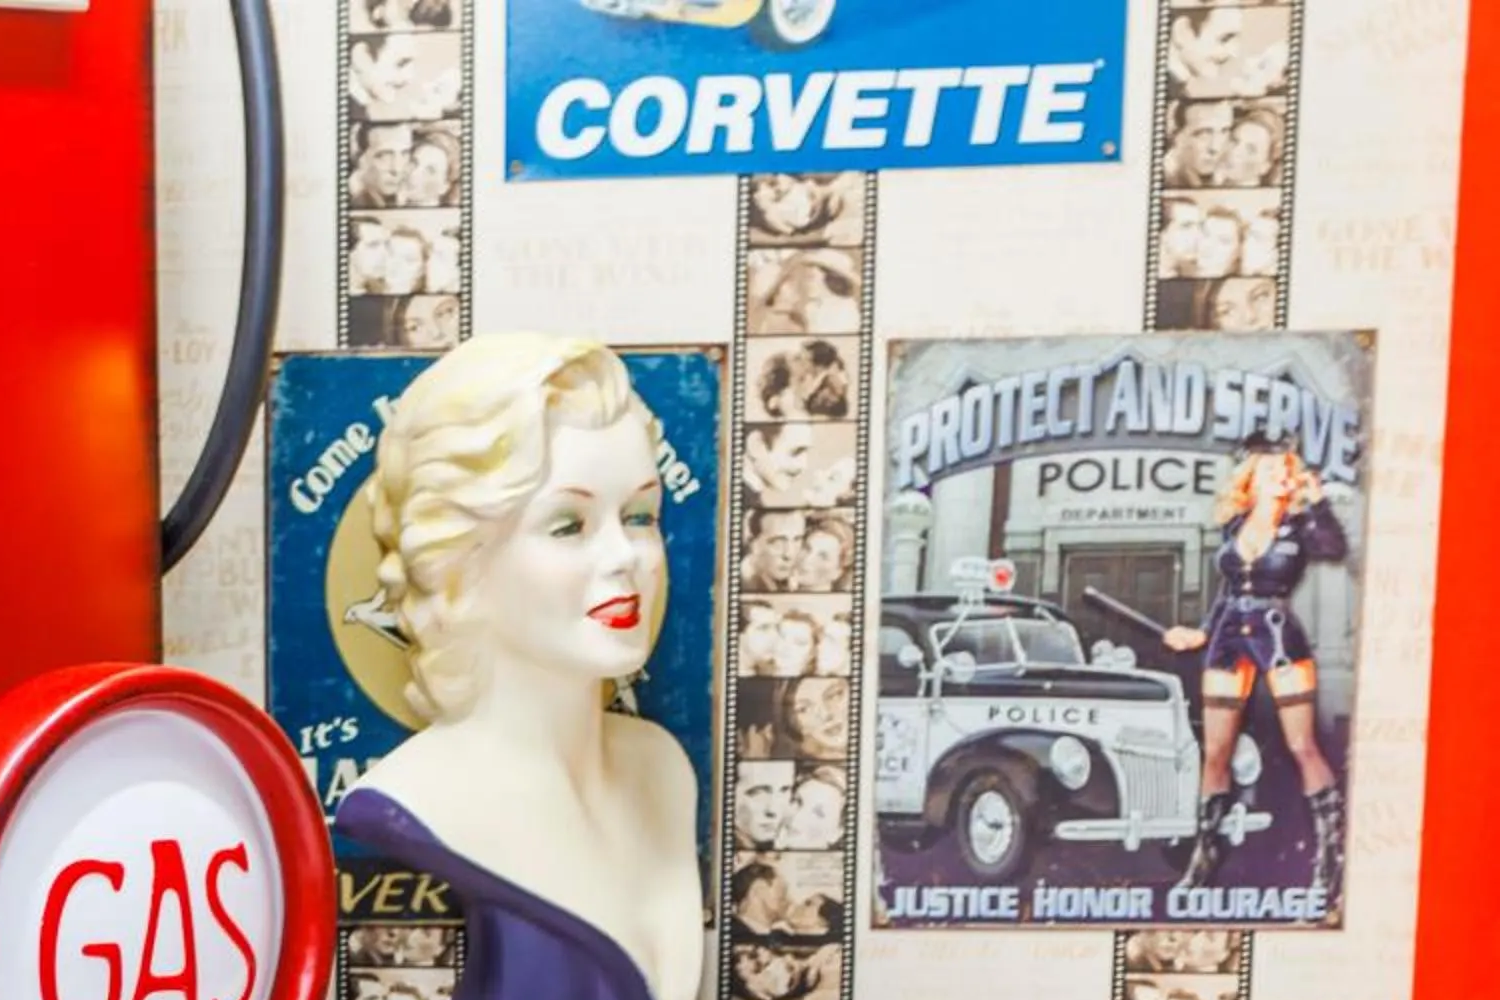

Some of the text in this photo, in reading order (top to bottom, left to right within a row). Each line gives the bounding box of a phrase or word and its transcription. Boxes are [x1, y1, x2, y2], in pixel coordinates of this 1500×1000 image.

[535, 62, 1100, 160] CORVETTE
[896, 358, 1360, 490] PROTECT AND SERVE
[290, 422, 376, 514] Come
[1037, 457, 1217, 497] POLICE
[1059, 505, 1188, 522] DEPARTMENT
[987, 705, 1102, 725] POLICE
[299, 716, 360, 755] It's
[887, 885, 1329, 920] JUSTICE HONOR COURAGE
